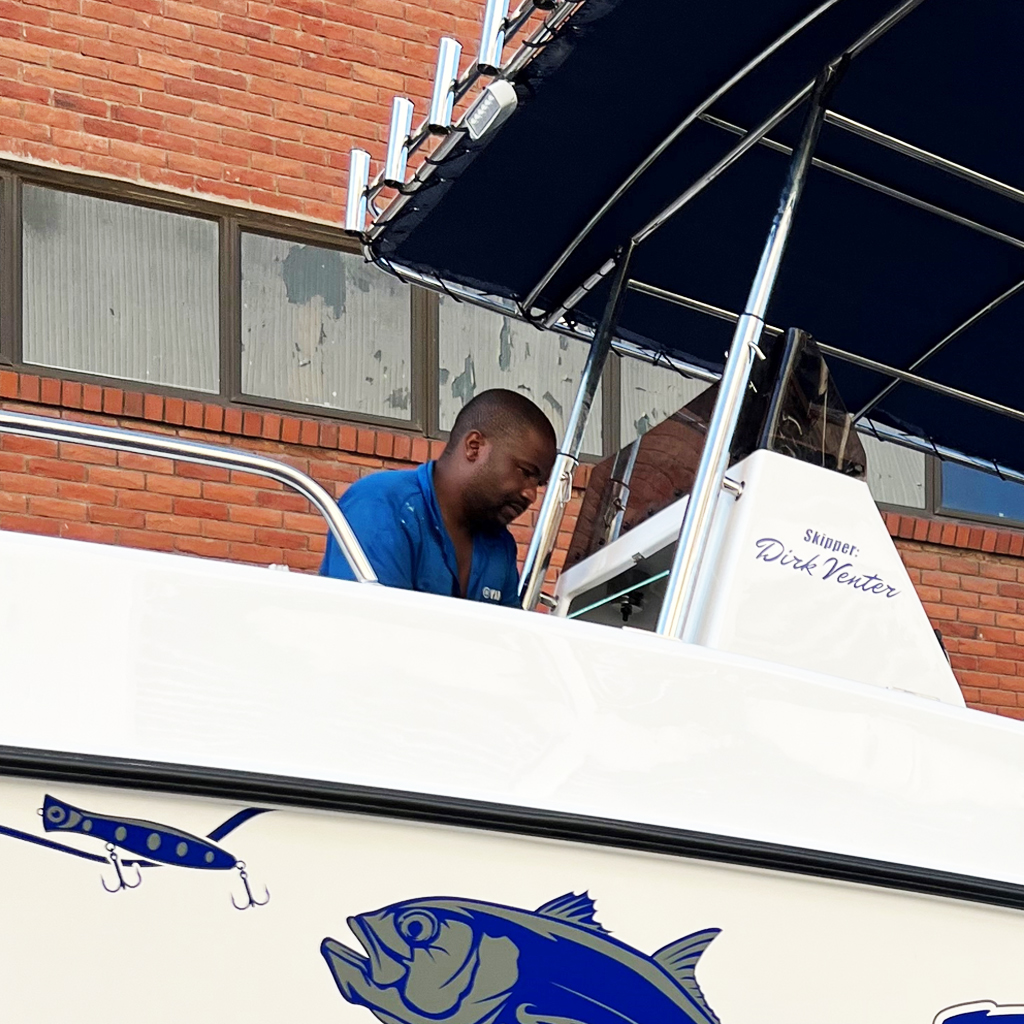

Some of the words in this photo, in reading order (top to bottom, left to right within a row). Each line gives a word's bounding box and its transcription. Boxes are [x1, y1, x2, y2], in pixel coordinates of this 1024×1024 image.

[803, 528, 861, 558] Skipper:
[755, 537, 821, 577] Dirk
[822, 557, 902, 599] Venter
